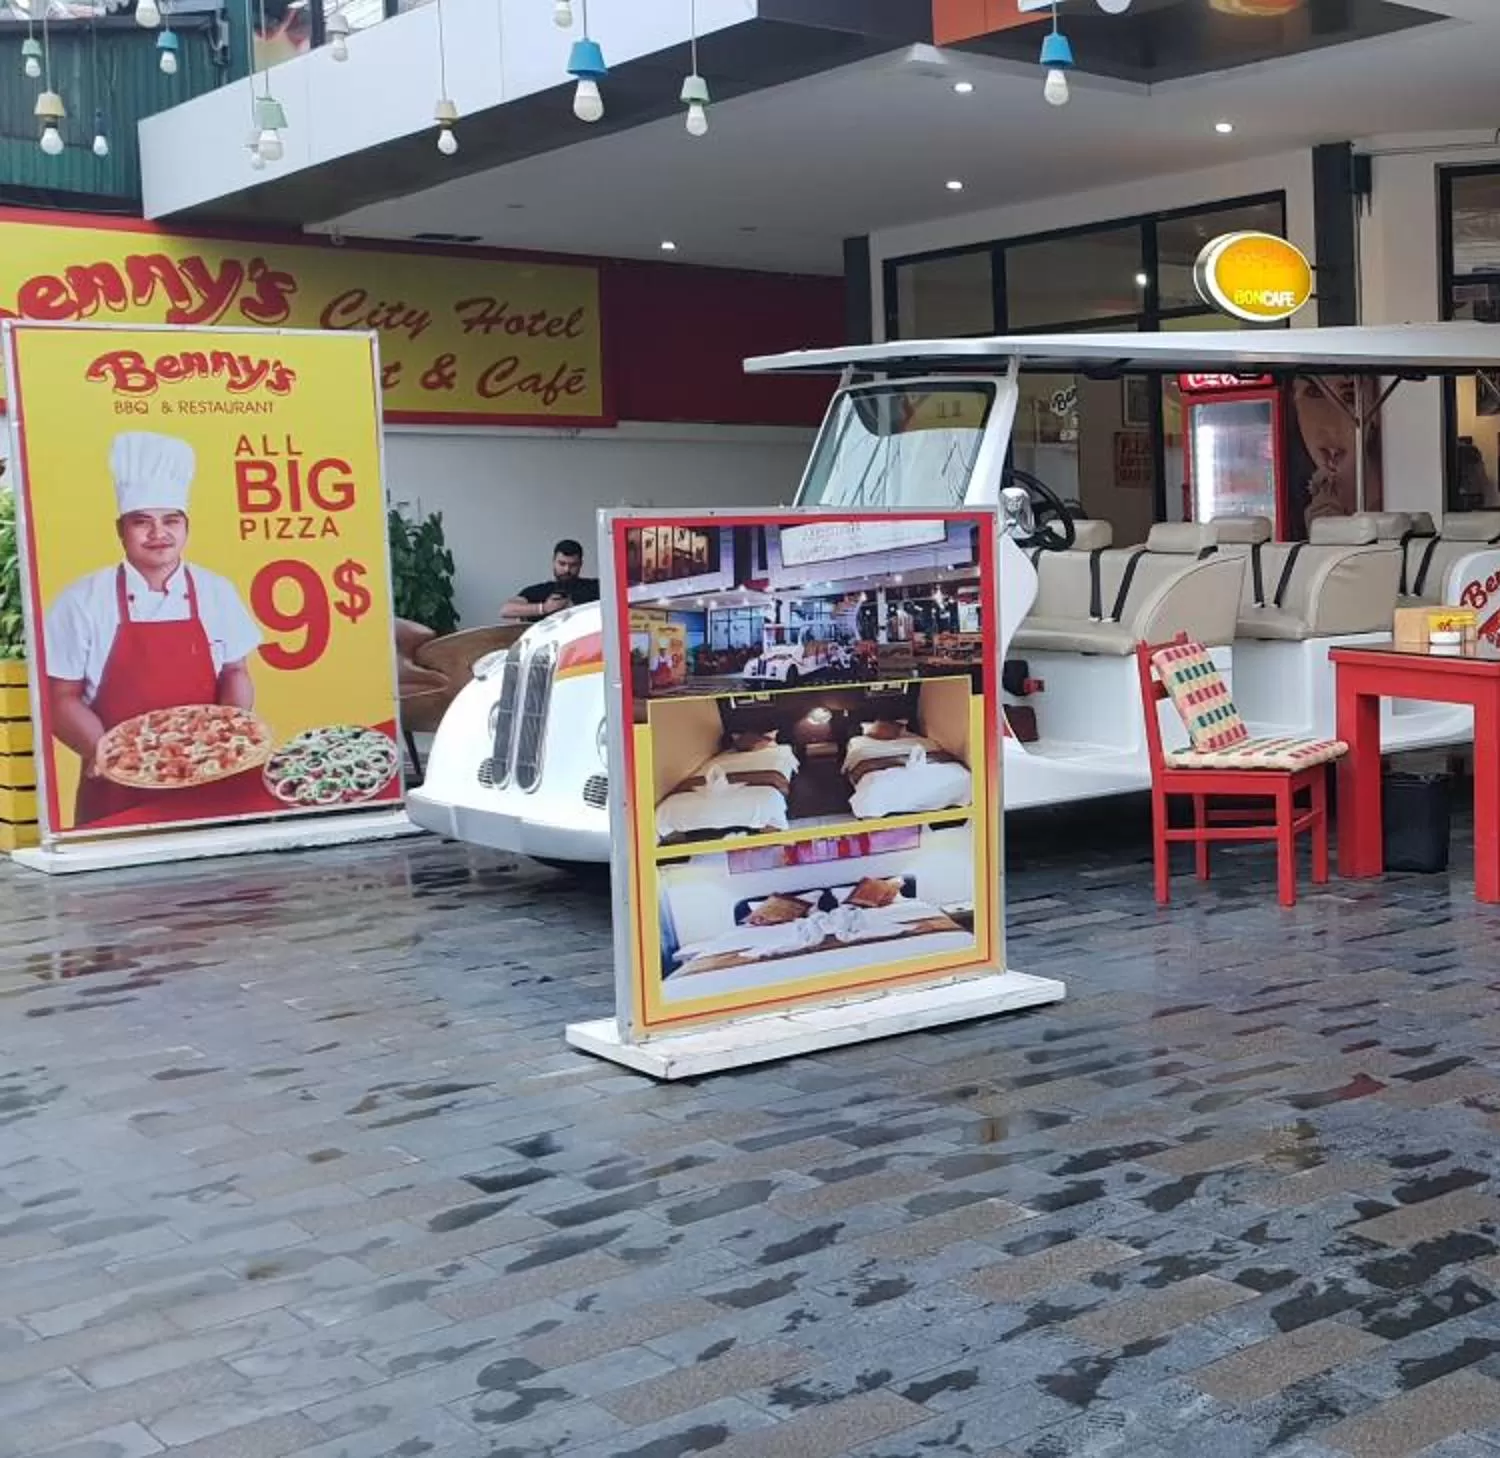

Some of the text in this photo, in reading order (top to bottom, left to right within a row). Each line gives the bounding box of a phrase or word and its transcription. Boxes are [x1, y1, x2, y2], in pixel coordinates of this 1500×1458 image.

[0, 253, 583, 341] enny's City Hotel
[85, 349, 297, 398] Benny's
[421, 353, 457, 393] &
[476, 356, 587, 406] Café
[113, 401, 274, 416] BBQ & RESTAURANT
[235, 434, 304, 457] ALL
[235, 458, 356, 513] BIG
[239, 516, 341, 541] PIZZA
